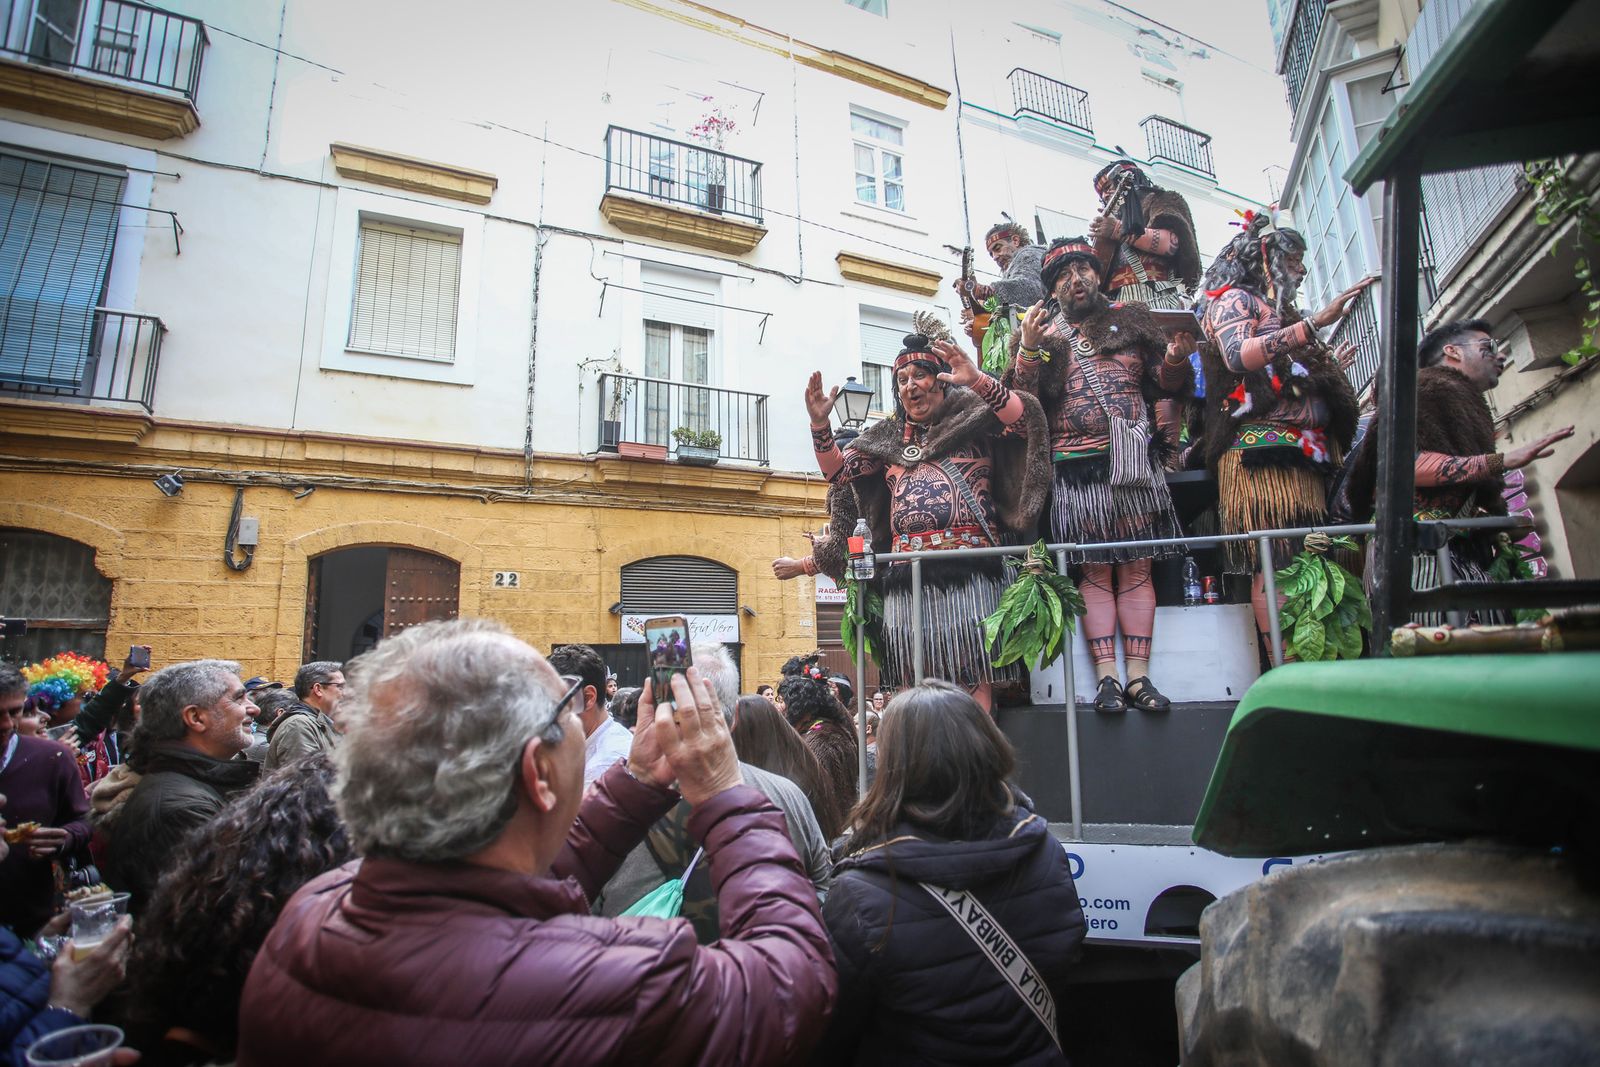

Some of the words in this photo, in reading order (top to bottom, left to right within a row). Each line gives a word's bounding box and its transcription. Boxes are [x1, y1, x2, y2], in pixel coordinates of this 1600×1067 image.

[495, 573, 517, 587] 22
[950, 894, 967, 914] Y
[1078, 897, 1131, 911] o.com
[966, 902, 1018, 969] BIMBA
[1019, 967, 1049, 1015] LOLA
